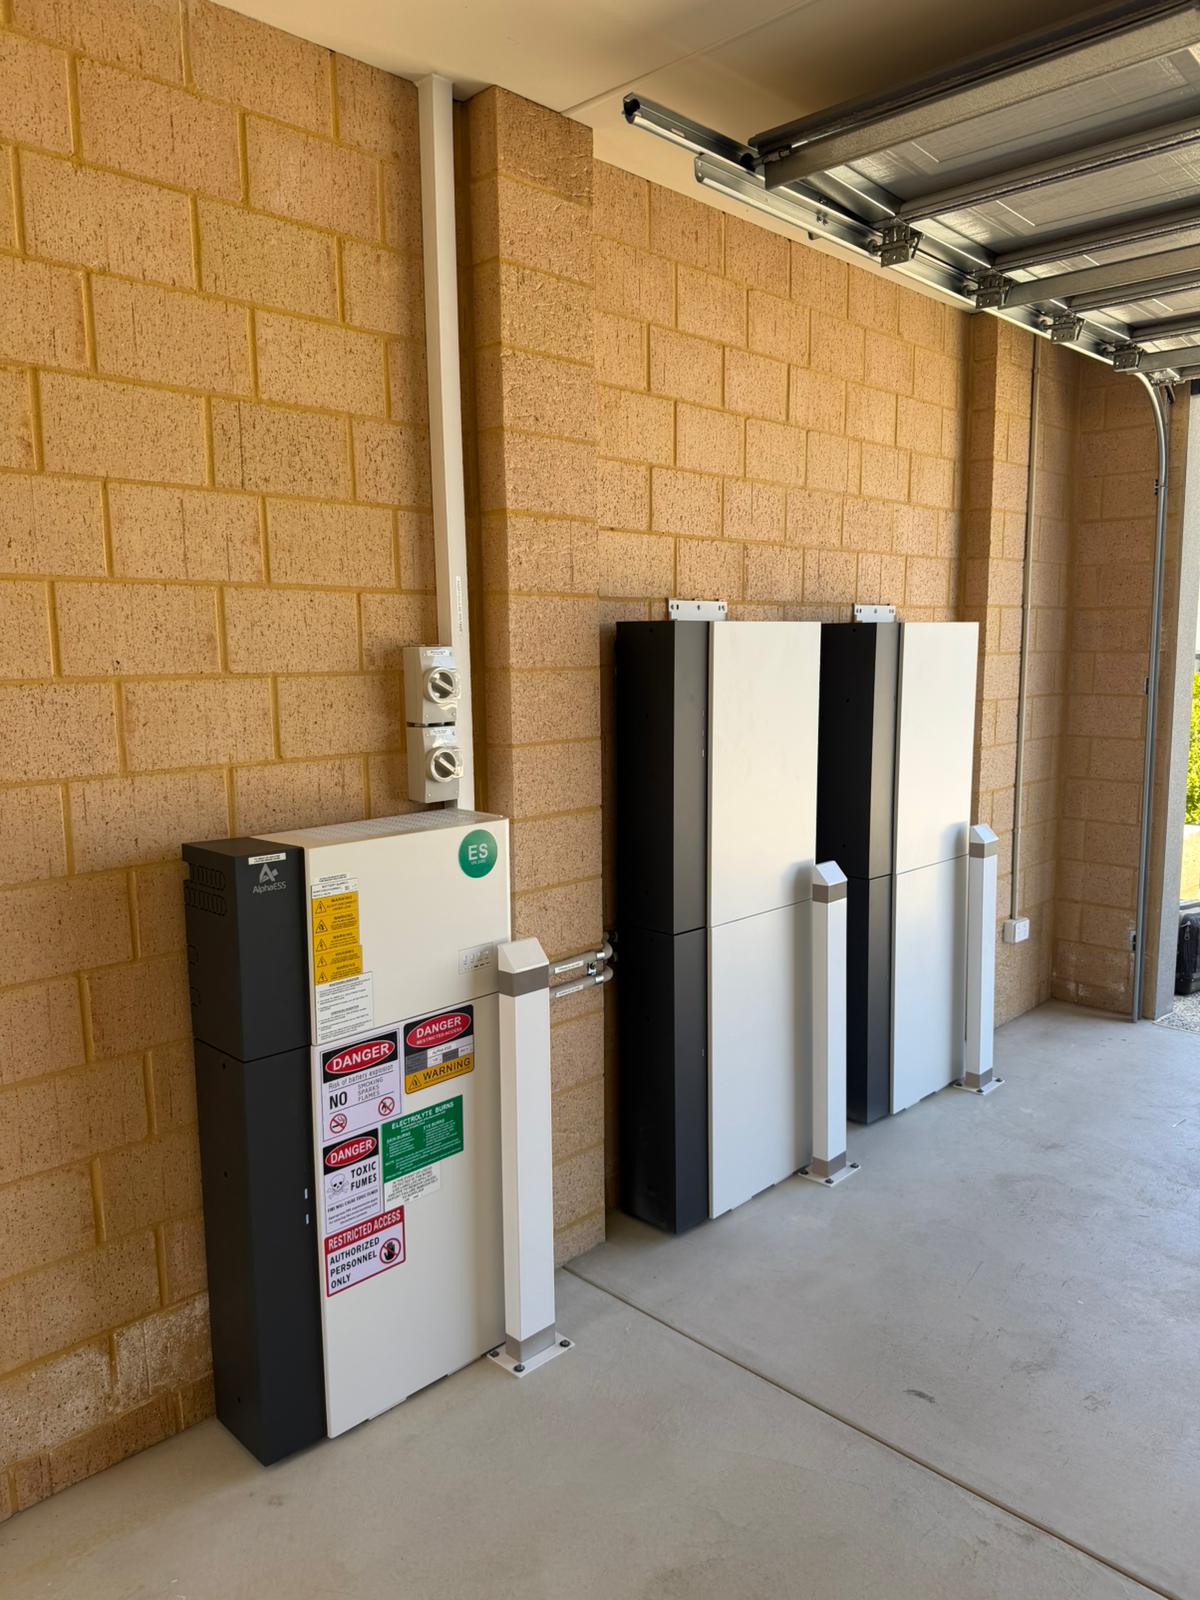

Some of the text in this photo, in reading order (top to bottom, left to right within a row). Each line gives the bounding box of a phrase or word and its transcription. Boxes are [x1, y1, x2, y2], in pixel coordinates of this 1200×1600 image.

[468, 843, 488, 860] ES
[253, 880, 287, 894] AlphaESS
[416, 1016, 462, 1038] DANGER
[332, 1042, 390, 1071] DANGER
[328, 1080, 341, 1090] Risk
[342, 1077, 348, 1086] of
[349, 1070, 368, 1083] battery
[369, 1064, 394, 1077] explosion
[423, 1057, 471, 1081] WARNING
[357, 1076, 384, 1089] SMOKING
[357, 1084, 380, 1096] SPARKS
[329, 1091, 348, 1110] NO
[357, 1090, 380, 1102] FLAMES
[391, 1109, 433, 1130] ELECTROLYTE
[434, 1101, 454, 1114] BURNS
[330, 1139, 373, 1165] DANGER
[351, 1161, 377, 1179] TOXIC
[350, 1173, 377, 1192] FUMES
[328, 1223, 373, 1249] RESTRICTED
[373, 1210, 401, 1230] ACCESS
[329, 1236, 380, 1266] AUTHORIZED
[330, 1251, 377, 1277] PERSONNEL
[331, 1273, 351, 1289] ONLY
